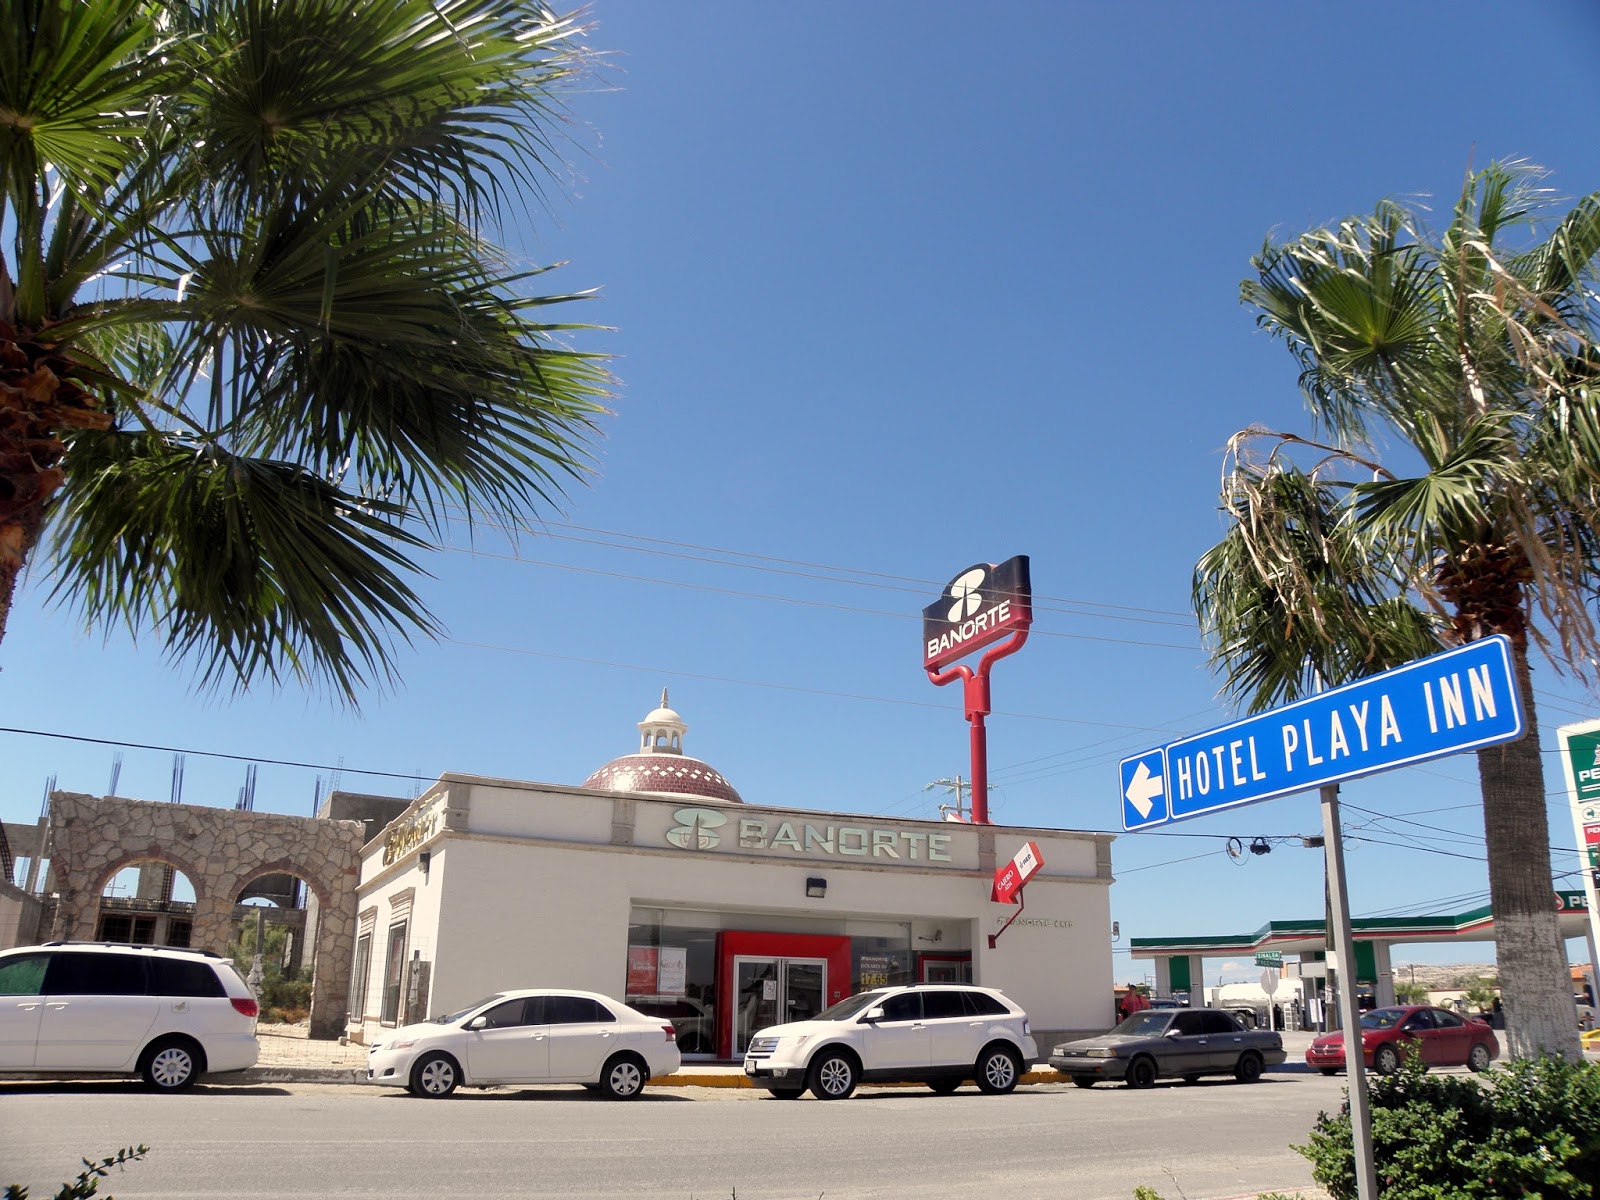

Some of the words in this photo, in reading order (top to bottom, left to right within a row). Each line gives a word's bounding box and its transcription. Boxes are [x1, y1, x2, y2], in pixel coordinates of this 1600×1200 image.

[927, 599, 1011, 659] BANORTE
[1177, 736, 1266, 800] HOTEL
[1282, 694, 1402, 772] PLAYA
[1423, 663, 1497, 733] INN
[739, 818, 952, 862] BANORTE
[997, 869, 1014, 890] CAJERO
[862, 974, 887, 984] 17.65
